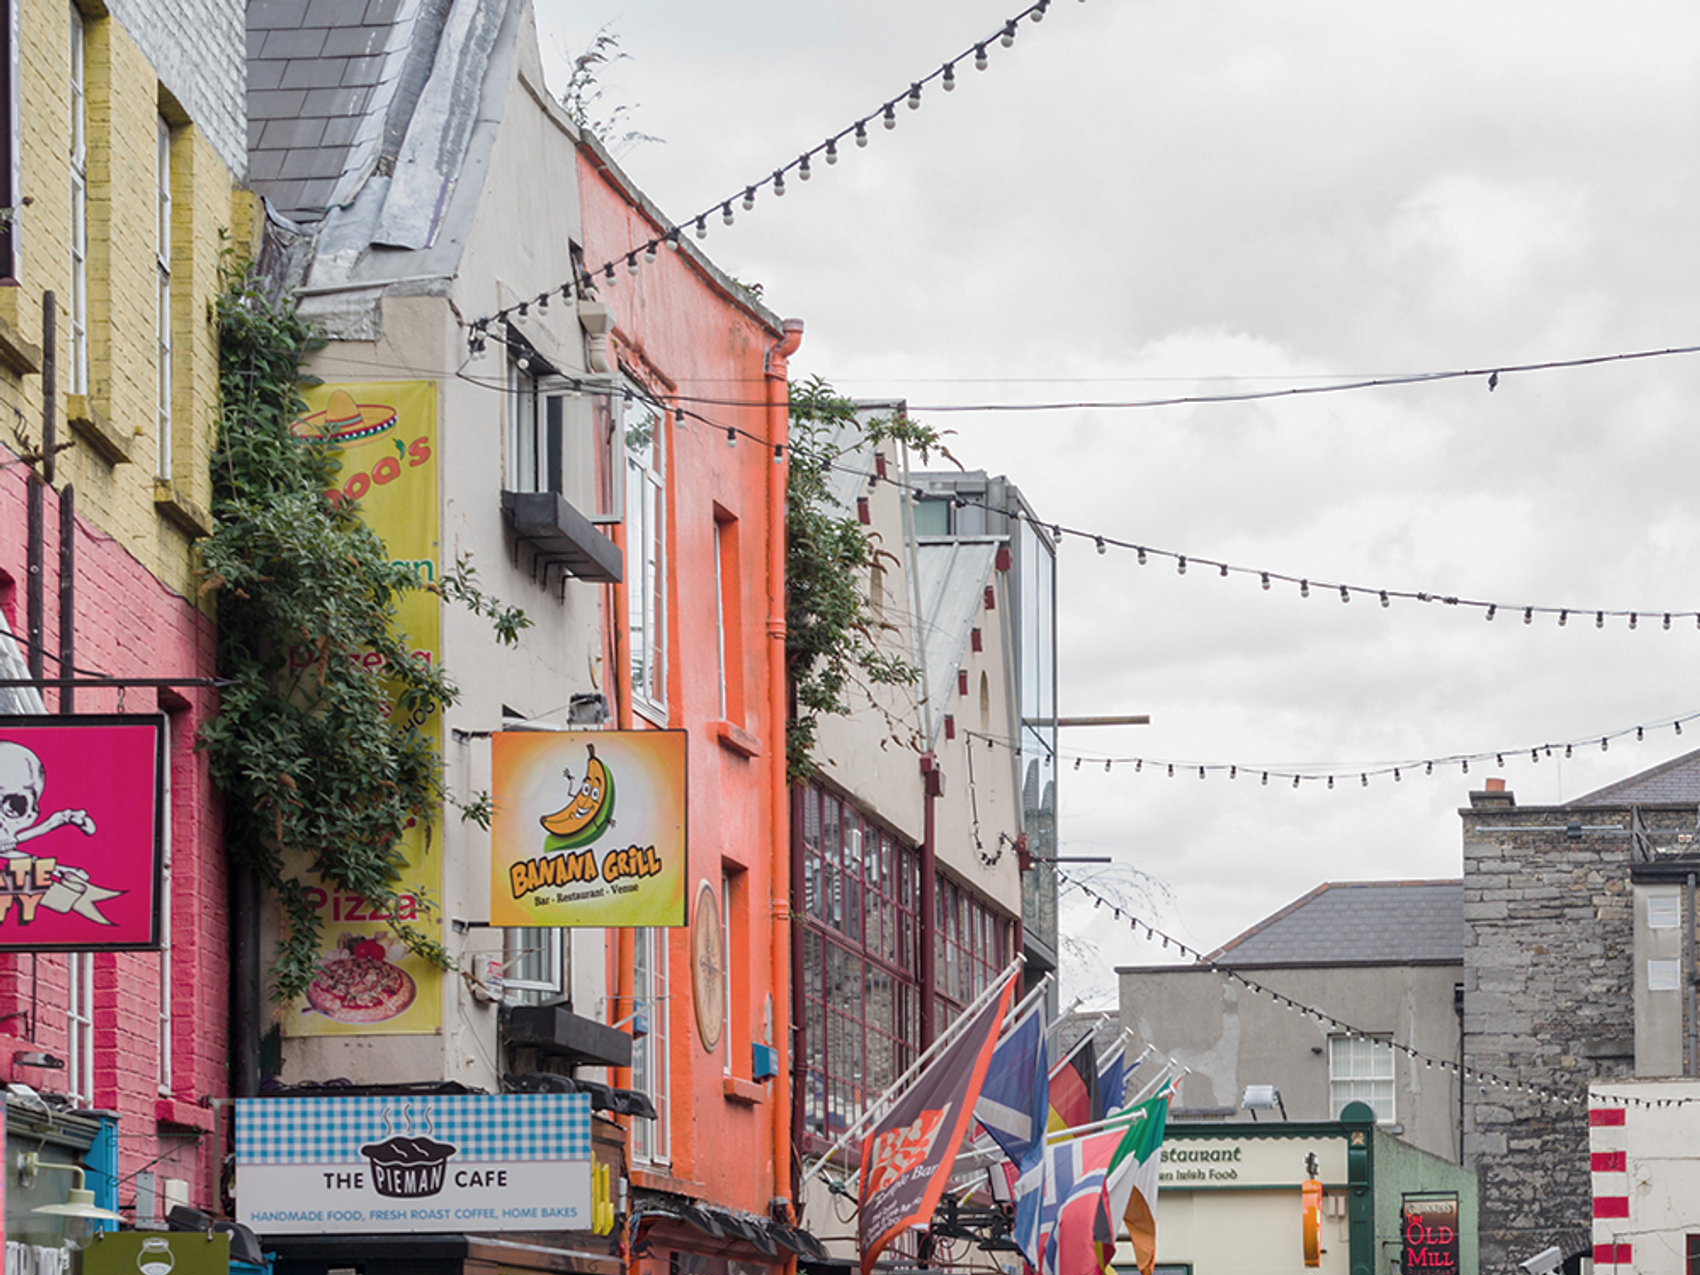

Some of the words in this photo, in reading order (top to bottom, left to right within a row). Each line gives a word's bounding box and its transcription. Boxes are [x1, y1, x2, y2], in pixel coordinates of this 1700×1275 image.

[509, 848, 599, 899] BANANA
[534, 894, 550, 907] Bar
[556, 887, 605, 903] Restaurant
[611, 882, 639, 896] Venue
[1160, 1146, 1242, 1163] staurant
[323, 1172, 364, 1190] THE
[454, 1170, 508, 1188] CAFE
[911, 1163, 940, 1181] Bar
[1208, 1167, 1238, 1180] Food
[251, 1210, 324, 1222] HANDMADE
[327, 1210, 366, 1223] FOOD,
[369, 1209, 407, 1221] FRESH
[410, 1208, 451, 1220] ROAST
[454, 1208, 499, 1220] COFFEE,
[502, 1207, 538, 1219] HOME
[541, 1206, 578, 1218] BAKES
[1406, 1222, 1454, 1246] OLD
[1407, 1246, 1455, 1267] MILL
